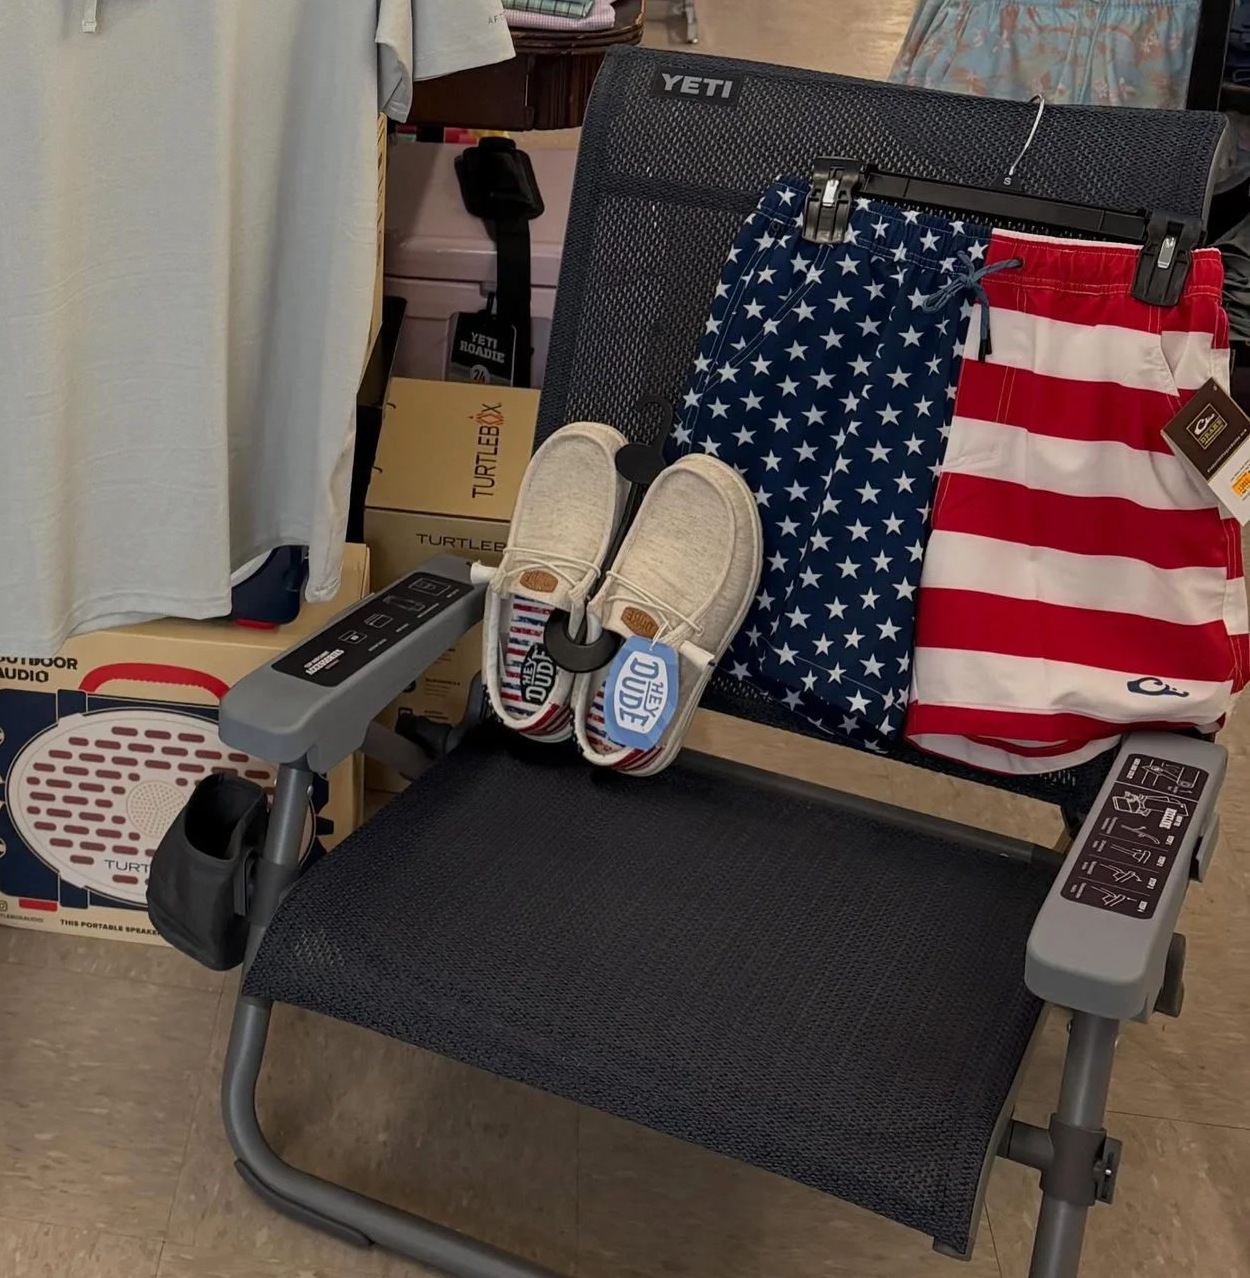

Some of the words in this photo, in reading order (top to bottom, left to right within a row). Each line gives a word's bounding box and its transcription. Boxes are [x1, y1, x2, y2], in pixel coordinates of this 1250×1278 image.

[661, 73, 733, 99] YETI
[1004, 177, 1012, 186] S
[459, 341, 505, 364] ROADIE
[470, 332, 498, 350] YETI
[472, 367, 486, 382] 24
[471, 402, 504, 499] TURTLEBOX
[522, 658, 537, 685] HEY
[619, 657, 660, 728] DUDE
[648, 682, 664, 719] HEY
[60, 918, 79, 927] THIS
[80, 921, 124, 932] PORTABLE
